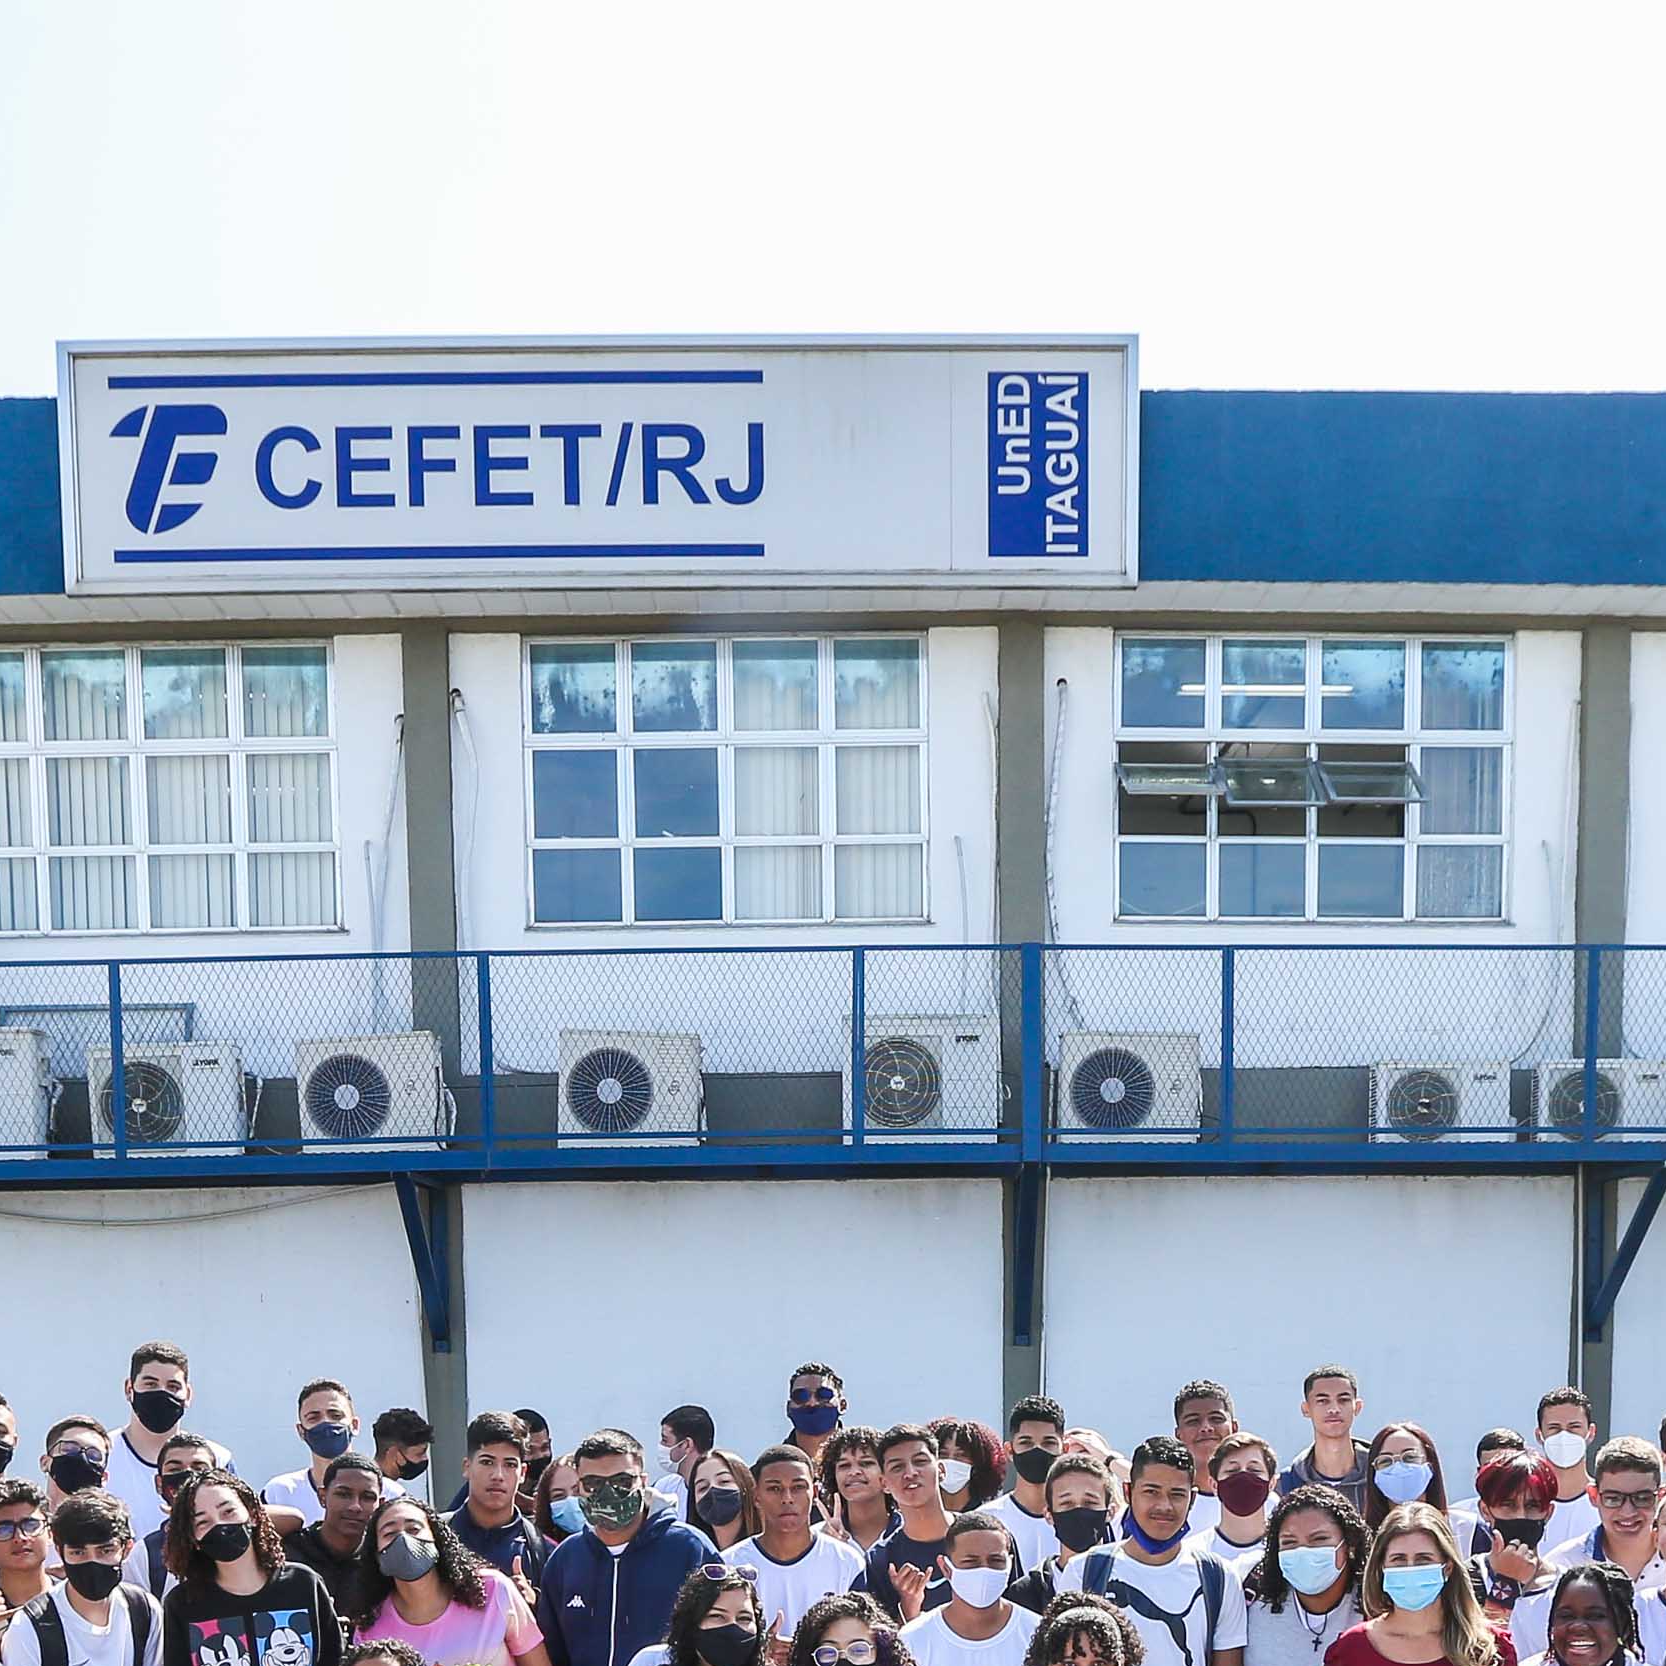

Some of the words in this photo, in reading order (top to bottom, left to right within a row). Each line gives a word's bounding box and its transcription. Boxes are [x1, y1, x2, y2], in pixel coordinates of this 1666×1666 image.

[254, 422, 764, 510] CEFET/RJ
[997, 374, 1031, 495] UnED
[1037, 374, 1079, 553] ITAGUAÍ
